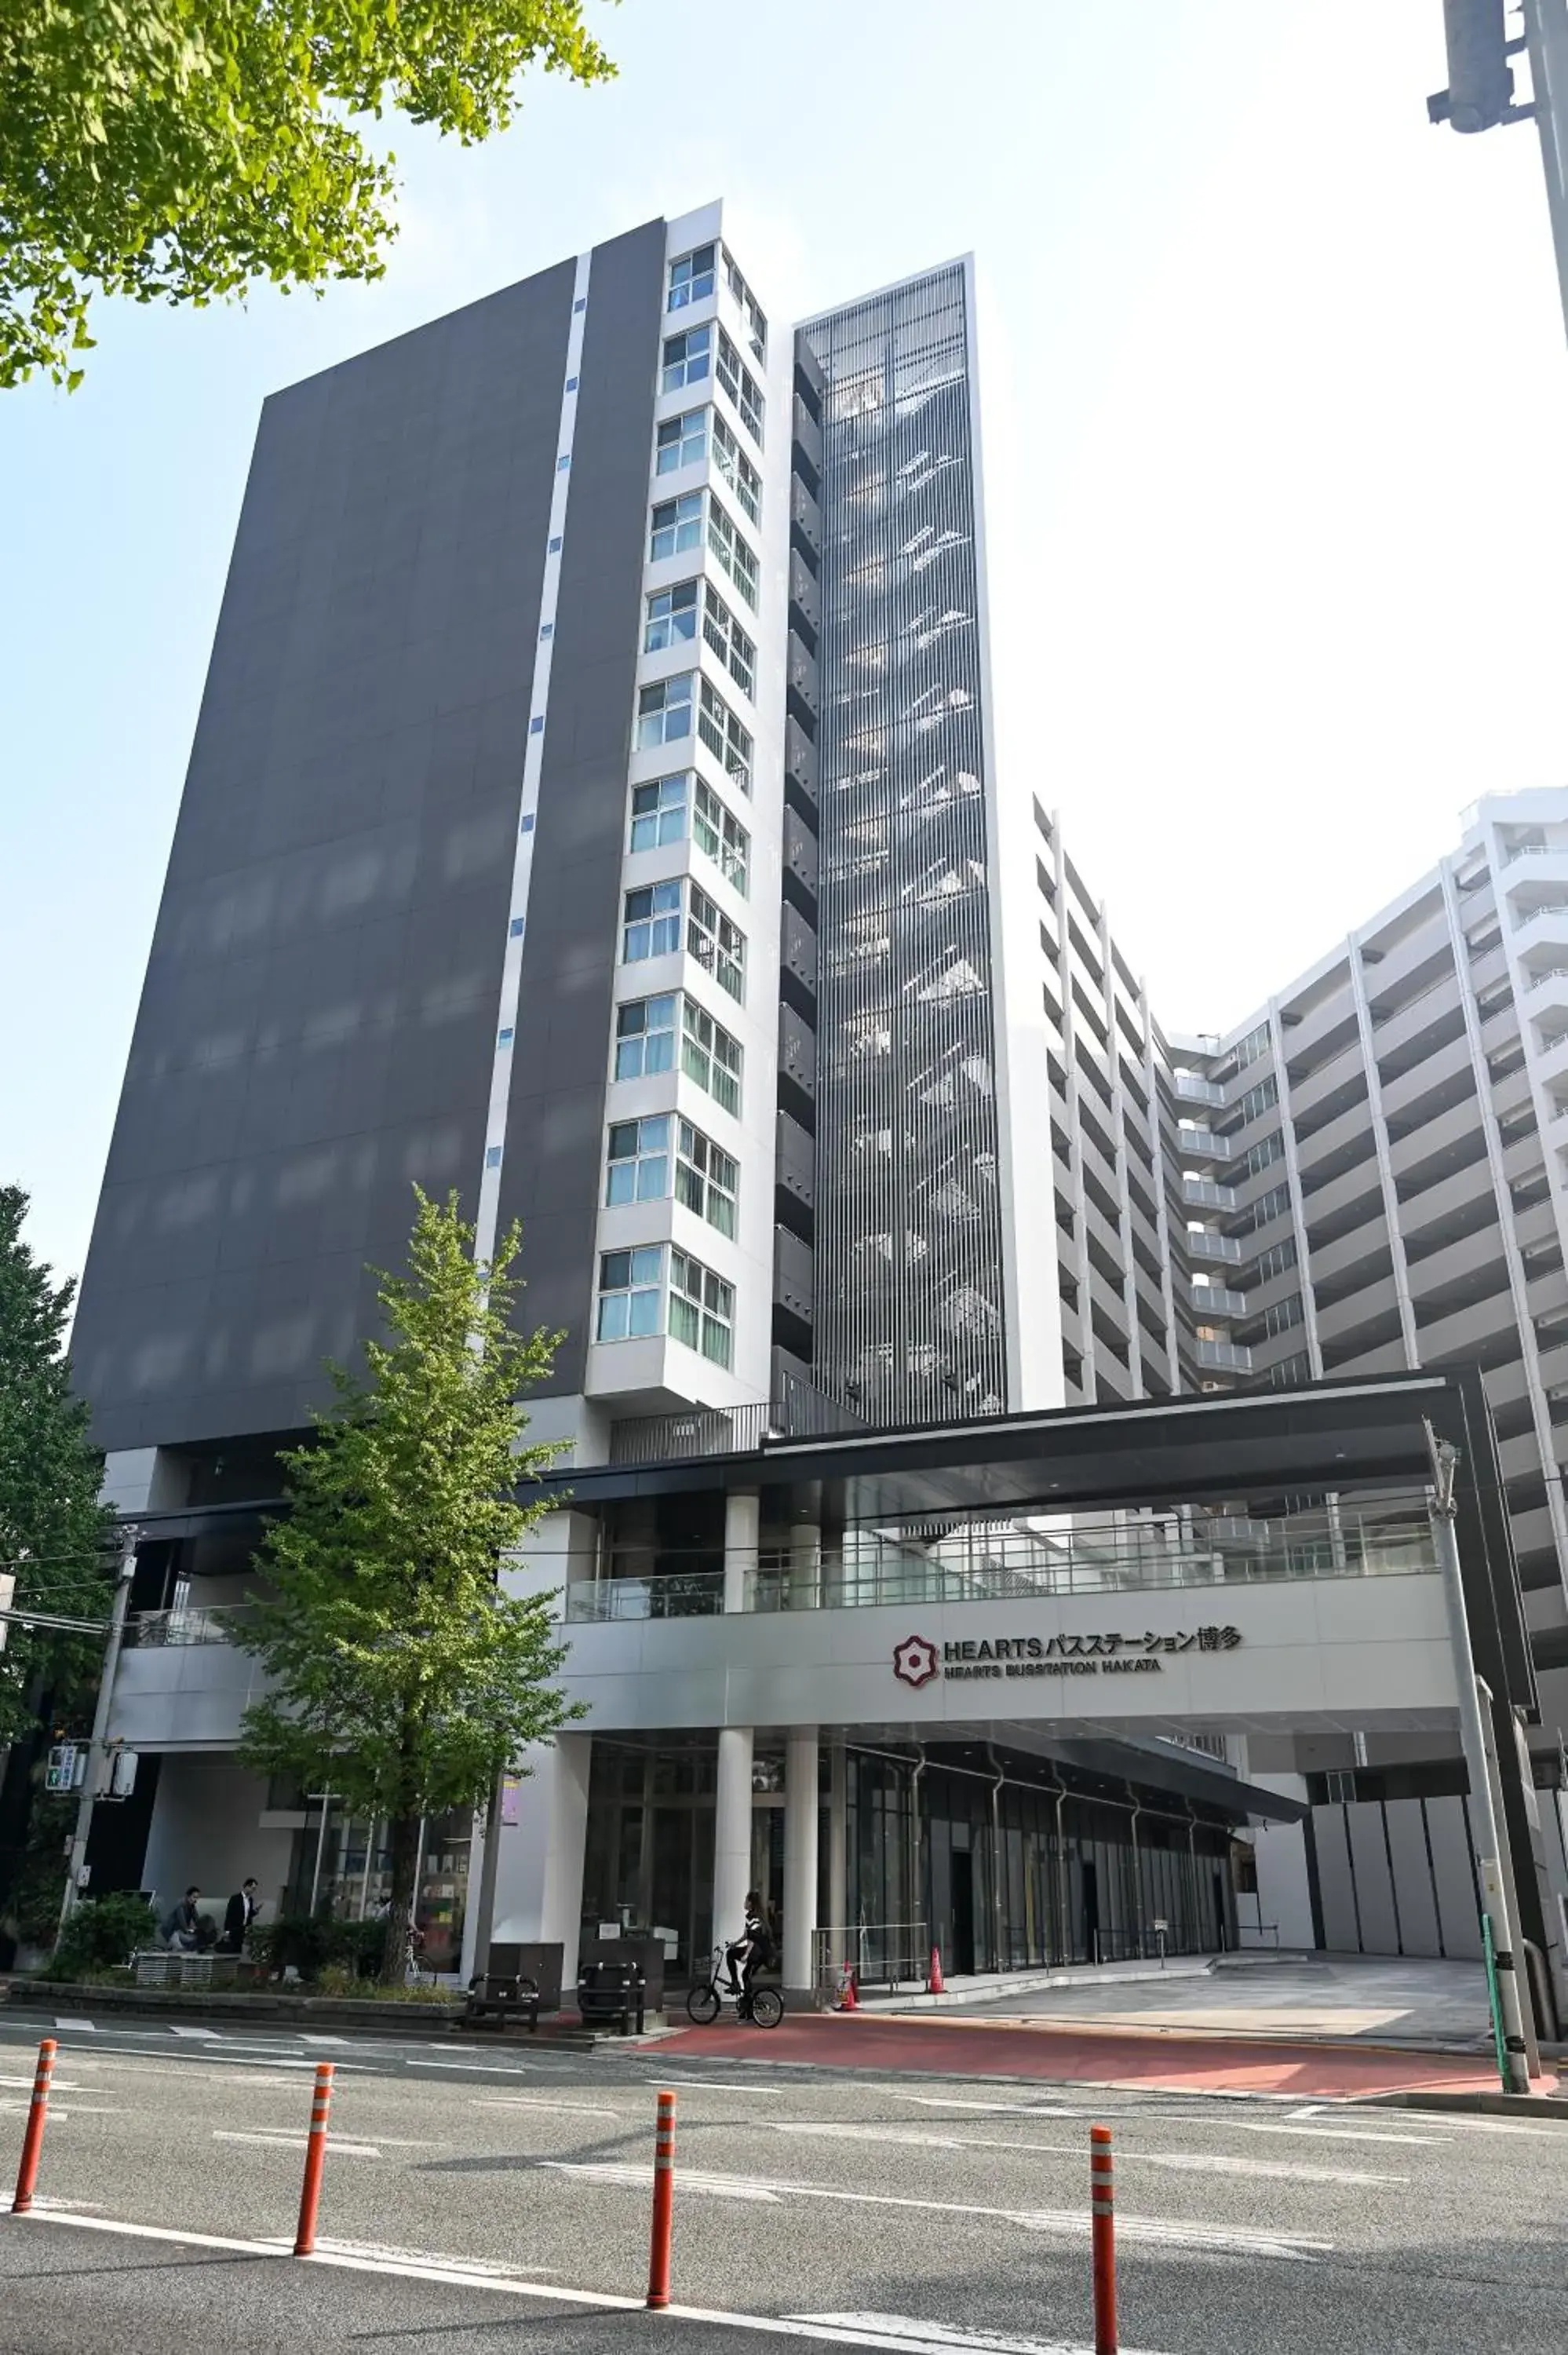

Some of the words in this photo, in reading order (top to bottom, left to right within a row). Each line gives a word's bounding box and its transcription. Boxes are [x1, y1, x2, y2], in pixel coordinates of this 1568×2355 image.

[944, 1665, 1001, 1679] HEARTS
[1005, 1661, 1096, 1677] BUSSTATION
[1102, 1659, 1161, 1673] HAKATA
